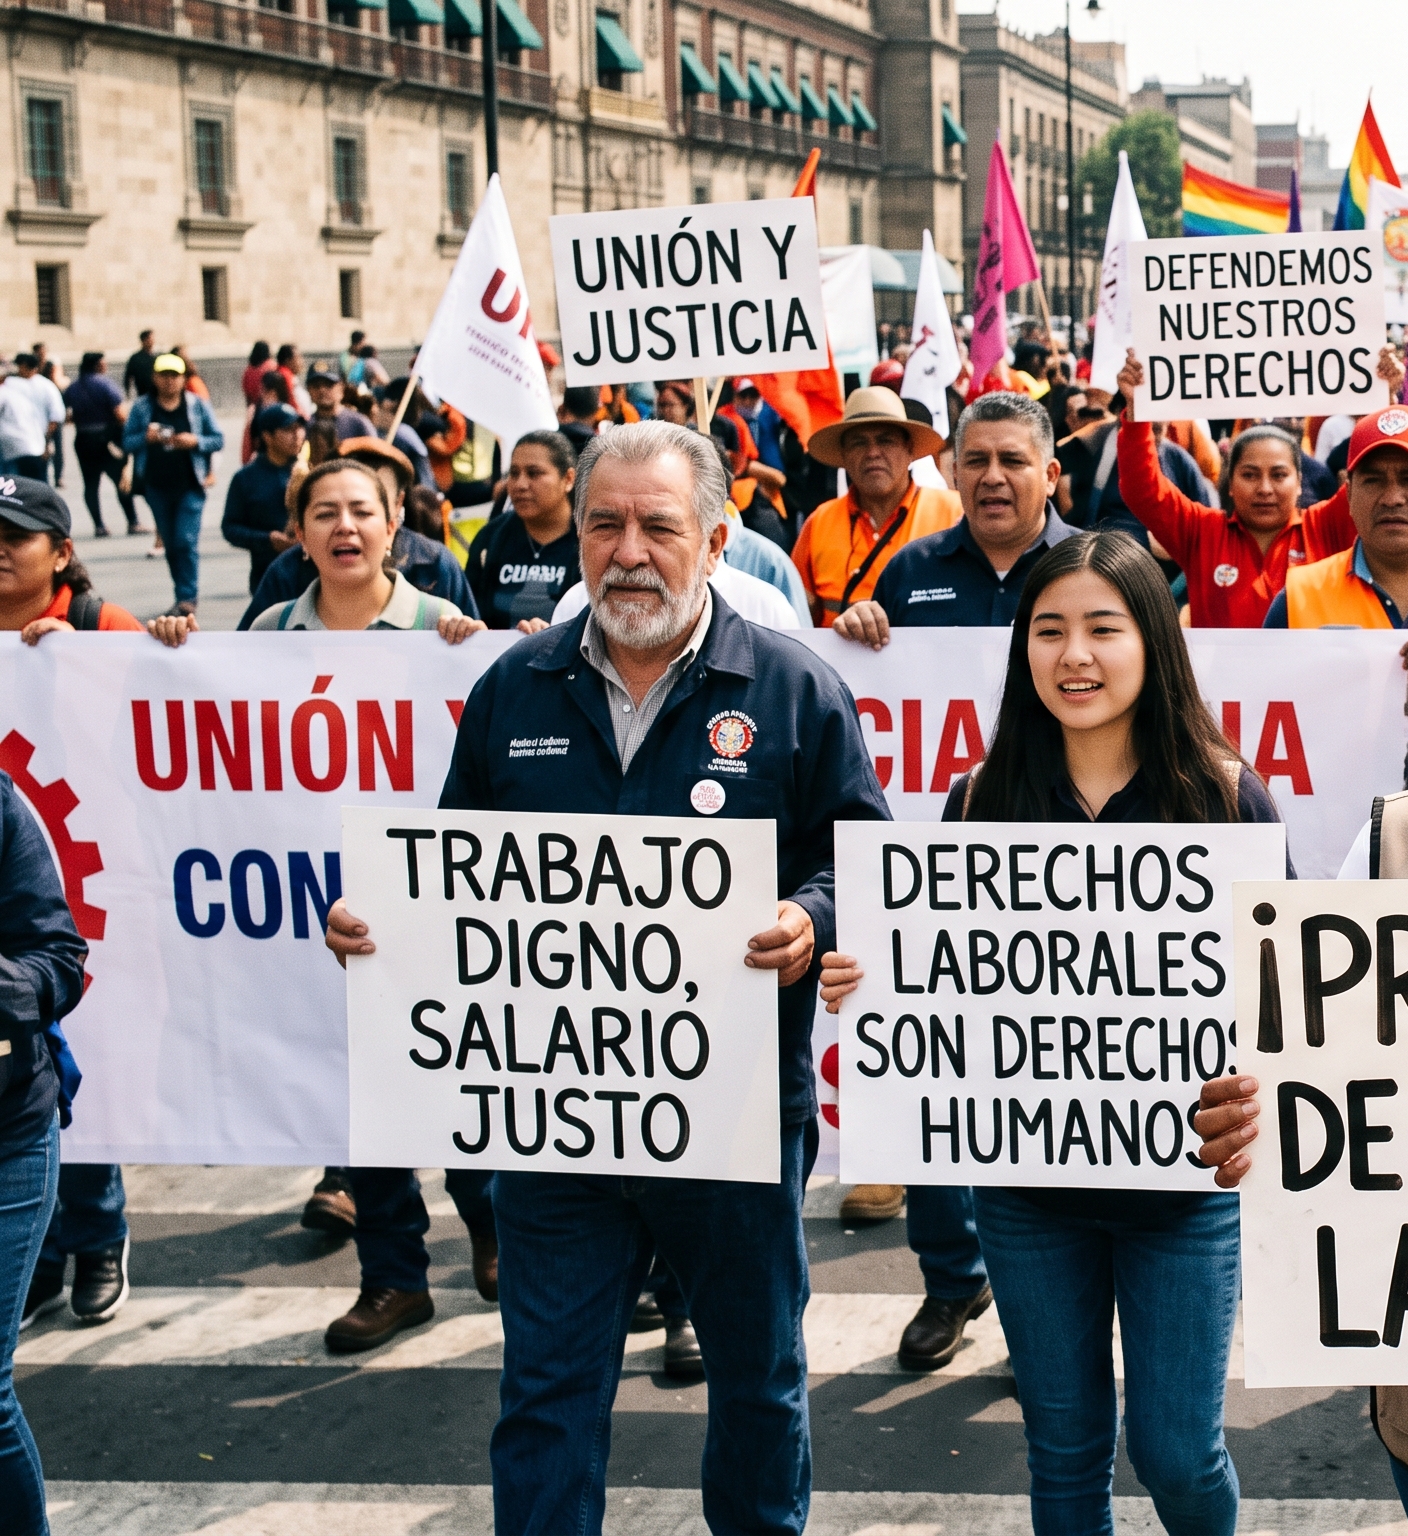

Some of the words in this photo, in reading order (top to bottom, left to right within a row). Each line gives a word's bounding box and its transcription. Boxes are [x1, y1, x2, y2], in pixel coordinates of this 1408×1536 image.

[573, 217, 741, 293] UNIÓN
[762, 225, 796, 279] Y
[1145, 247, 1371, 291] DEFENDEMOS
[573, 298, 817, 366] JUSTICIA
[1160, 297, 1355, 341] NUESTROS
[1149, 348, 1372, 400] DERECHOS
[132, 674, 414, 792] UNIÓN
[173, 848, 342, 939] CON
[387, 829, 731, 909] TRABAJO
[883, 844, 1213, 912] DERECHOS
[456, 917, 698, 1003] DIGNO,
[892, 929, 1225, 997] LABORALES
[410, 999, 709, 1080] SALARIO
[857, 1013, 965, 1078] SON
[453, 1085, 689, 1162] JUSTO
[1278, 1079, 1402, 1191] DE
